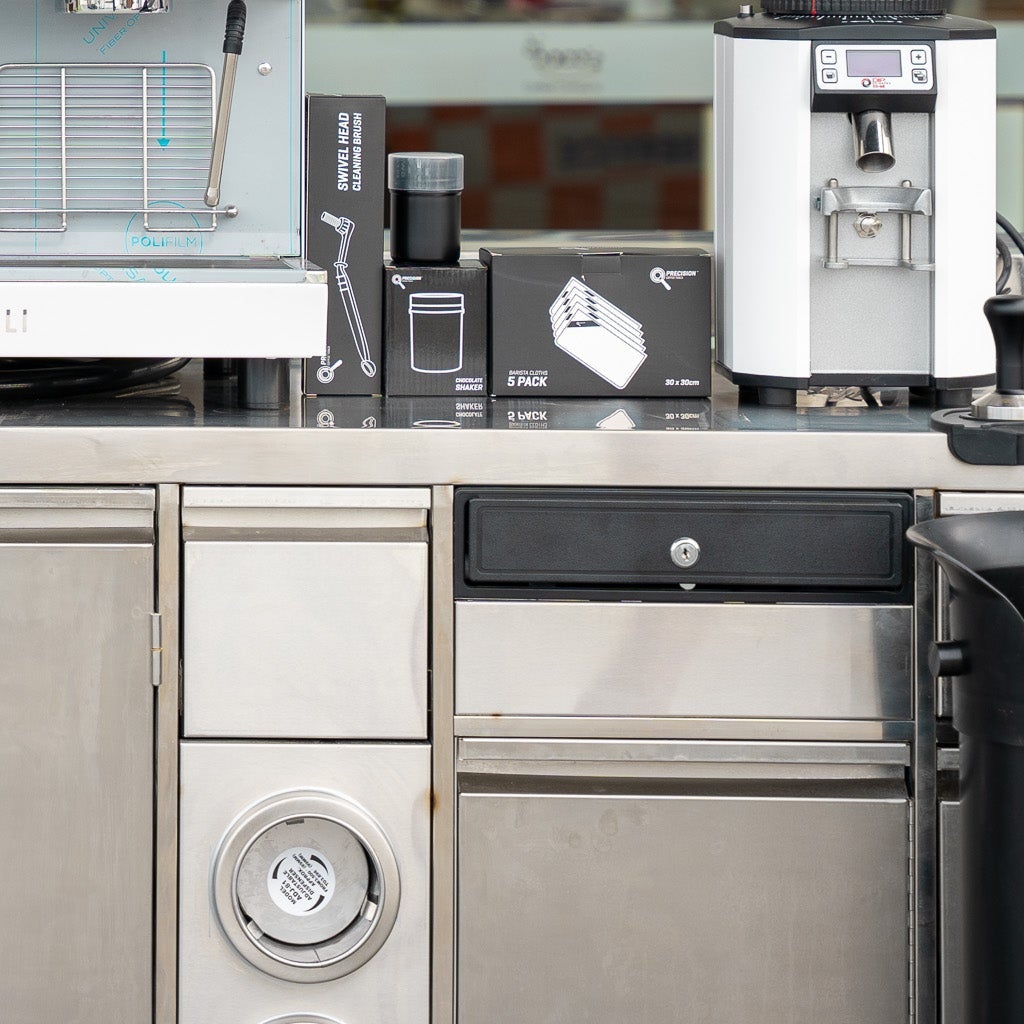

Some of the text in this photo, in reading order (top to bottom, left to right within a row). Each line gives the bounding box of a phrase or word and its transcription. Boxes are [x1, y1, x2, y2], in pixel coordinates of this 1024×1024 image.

[99, 28, 127, 55] FIBER
[337, 112, 350, 192] SWIVEL HEAD
[352, 112, 362, 192] CLEANING BRUSH
[131, 236, 197, 247] POLIFILM
[507, 376, 548, 387] 5 PACK
[280, 885, 296, 904] MODEL
[283, 871, 312, 900] ADJUSTABLE
[289, 868, 314, 895] DISPENSER
